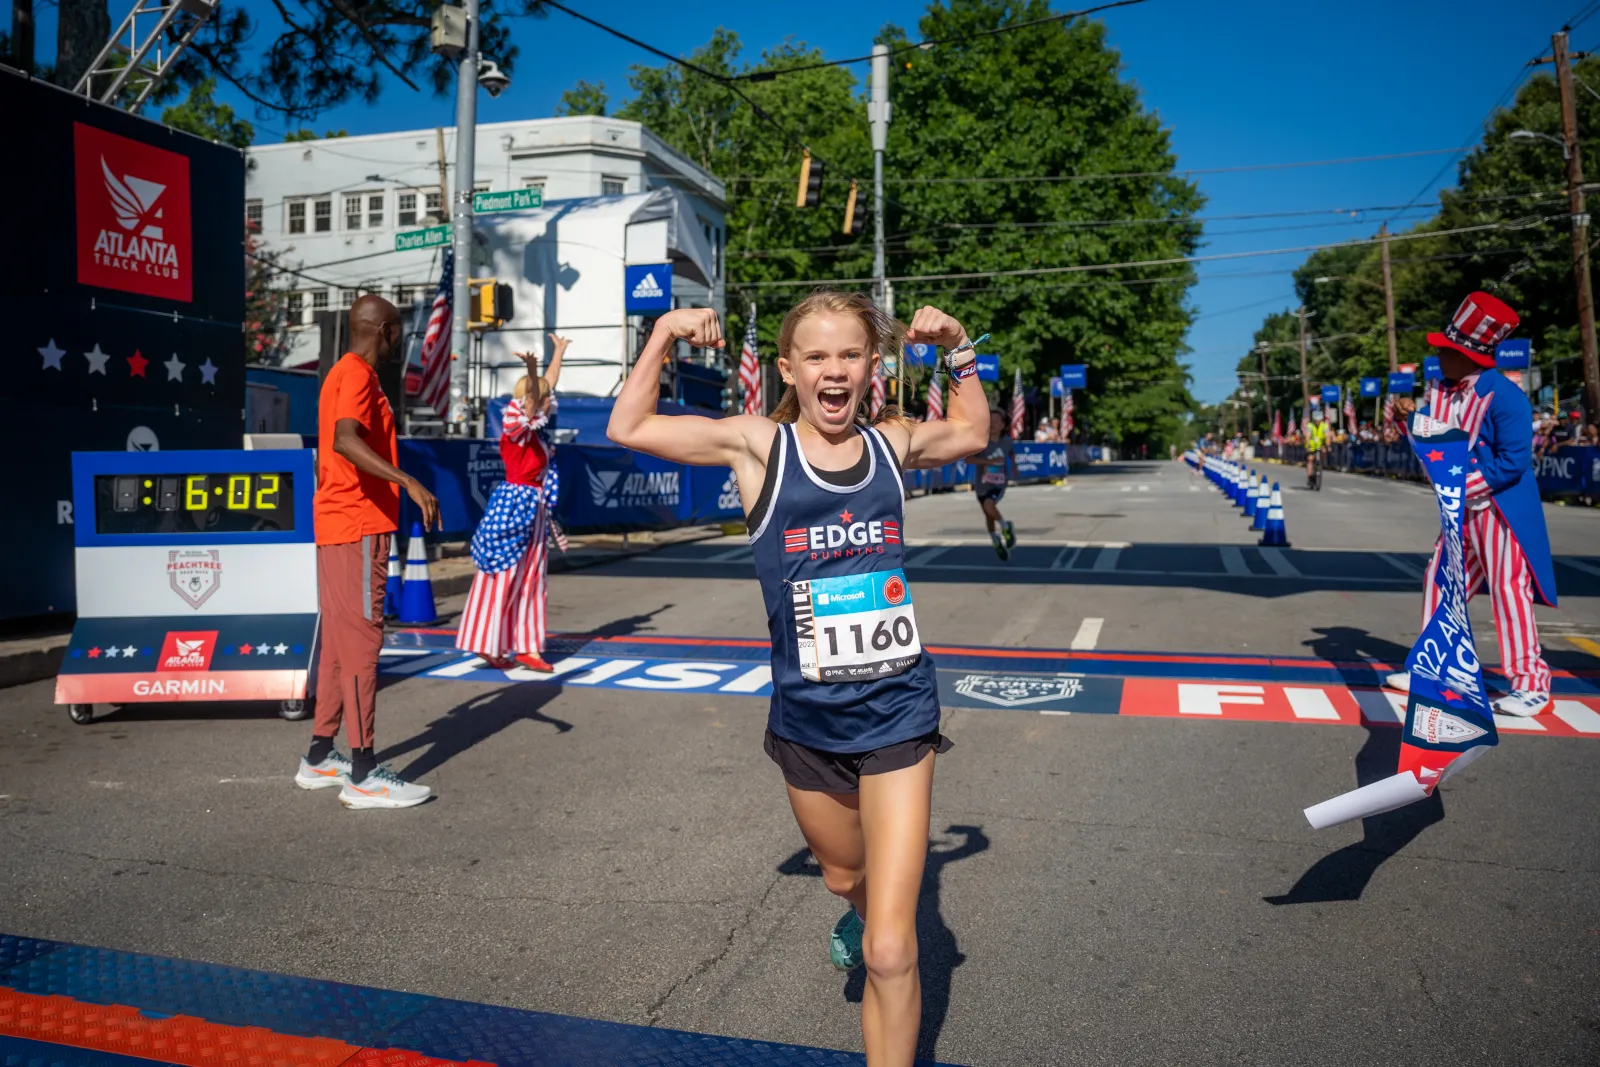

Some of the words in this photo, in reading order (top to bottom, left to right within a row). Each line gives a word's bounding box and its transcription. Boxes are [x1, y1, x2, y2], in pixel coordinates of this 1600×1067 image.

[475, 195, 513, 211] Piedmont
[514, 193, 532, 207] Park
[397, 234, 424, 249] Charles
[425, 230, 443, 245] Allen
[94, 229, 179, 269] ATLANTA
[94, 252, 139, 273] TRACK
[145, 263, 179, 280] CLUB
[467, 459, 506, 473] PEACHT
[1541, 456, 1576, 480] PNC
[621, 471, 680, 496] ATLANTA
[619, 496, 651, 508] TRACK
[658, 494, 680, 506] CLUB
[718, 493, 744, 510] adi
[810, 521, 884, 550] EDGE
[811, 545, 885, 561] RUNNING
[167, 561, 222, 570] PEACHTREE
[830, 591, 866, 602] Microsoft
[824, 615, 914, 656] 1160
[798, 641, 816, 649] 2022
[1412, 638, 1448, 680] 022
[133, 679, 226, 696] GARMIN
[1427, 707, 1441, 743] PEACHTREE
